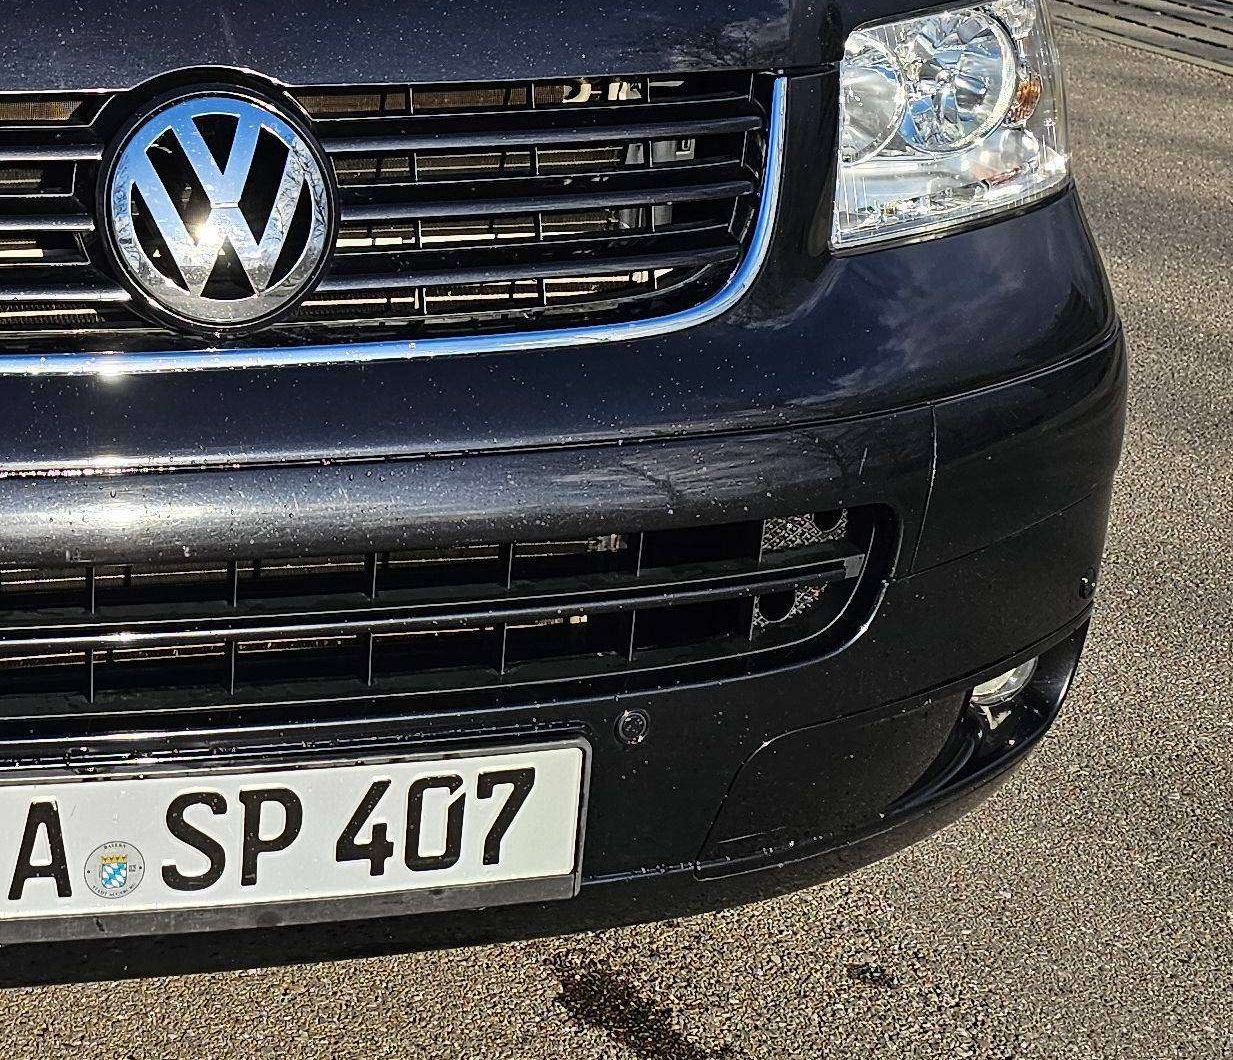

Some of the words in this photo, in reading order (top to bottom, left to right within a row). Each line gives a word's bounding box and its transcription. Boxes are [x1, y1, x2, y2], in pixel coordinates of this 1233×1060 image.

[8, 800, 73, 901] A
[161, 787, 303, 892] SP
[335, 766, 536, 877] 407
